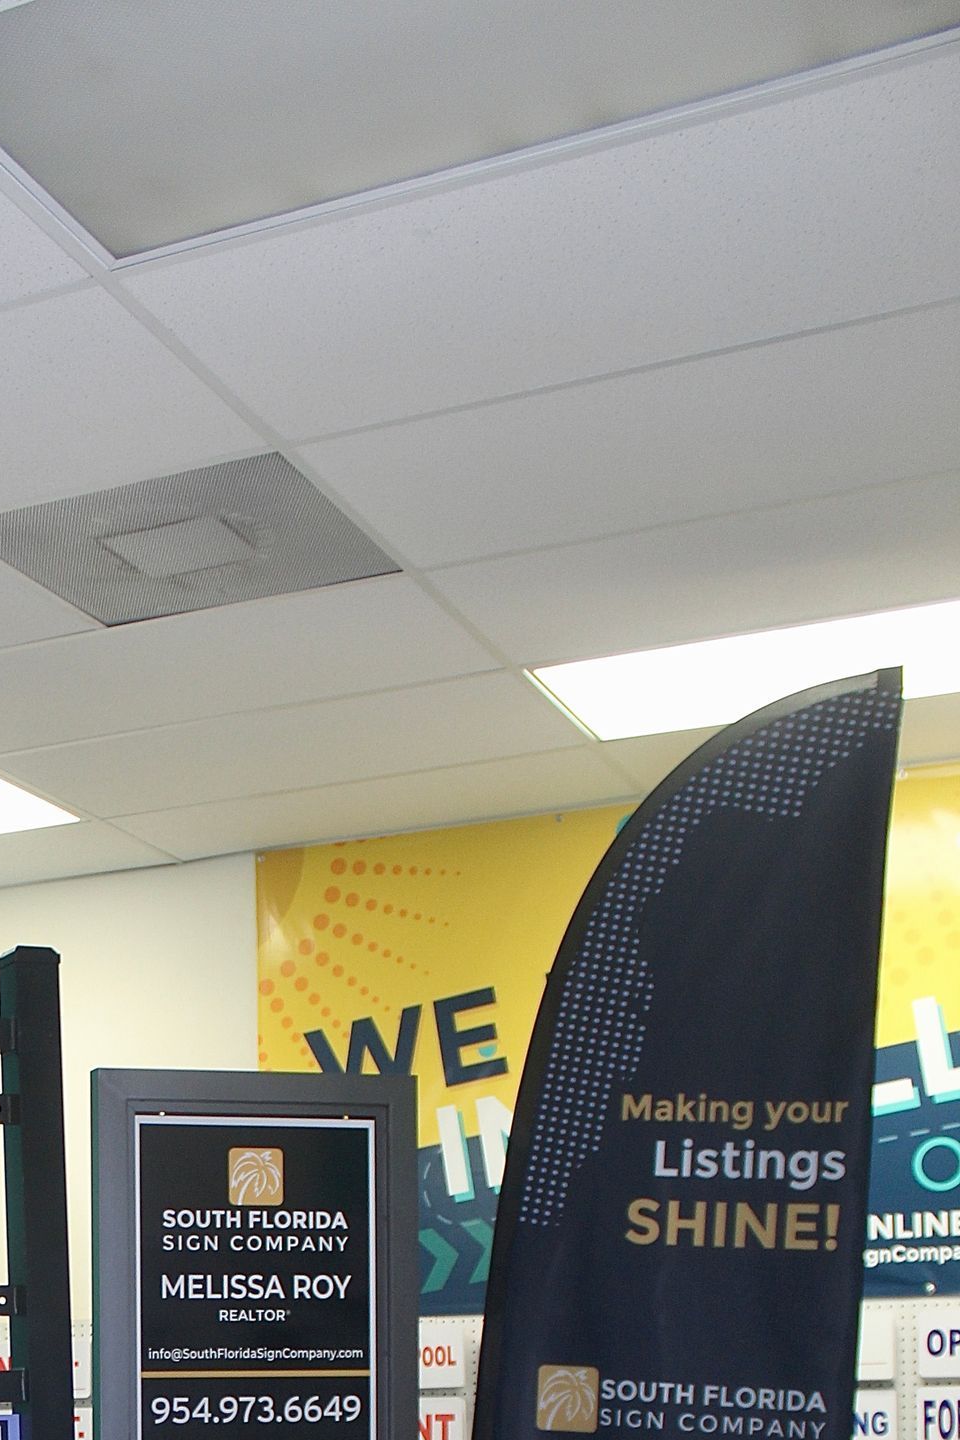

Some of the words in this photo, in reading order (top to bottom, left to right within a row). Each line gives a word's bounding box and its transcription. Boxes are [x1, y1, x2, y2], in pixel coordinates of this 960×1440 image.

[302, 986, 511, 1088] WE
[621, 1093, 753, 1130] Making
[766, 1100, 849, 1130] your
[654, 1139, 846, 1190] Listings
[162, 1209, 241, 1229] SOUTH
[248, 1211, 348, 1230] FLORIDA
[625, 1198, 840, 1251] SHINE!
[162, 1234, 219, 1251] SIGN
[230, 1236, 348, 1252] COMPANY
[161, 1274, 285, 1300] MELISSA
[294, 1275, 351, 1299] ROY
[148, 1346, 363, 1362] info@SouthFloridaSignCompany.com
[419, 1346, 456, 1367] OOL
[151, 1395, 361, 1424] 954.973.6649
[602, 1380, 693, 1405] SOUTH
[704, 1385, 826, 1413] FLORIDA
[600, 1408, 664, 1430] SIGN
[679, 1413, 826, 1440] COMPANY
[924, 1400, 960, 1440] FO
